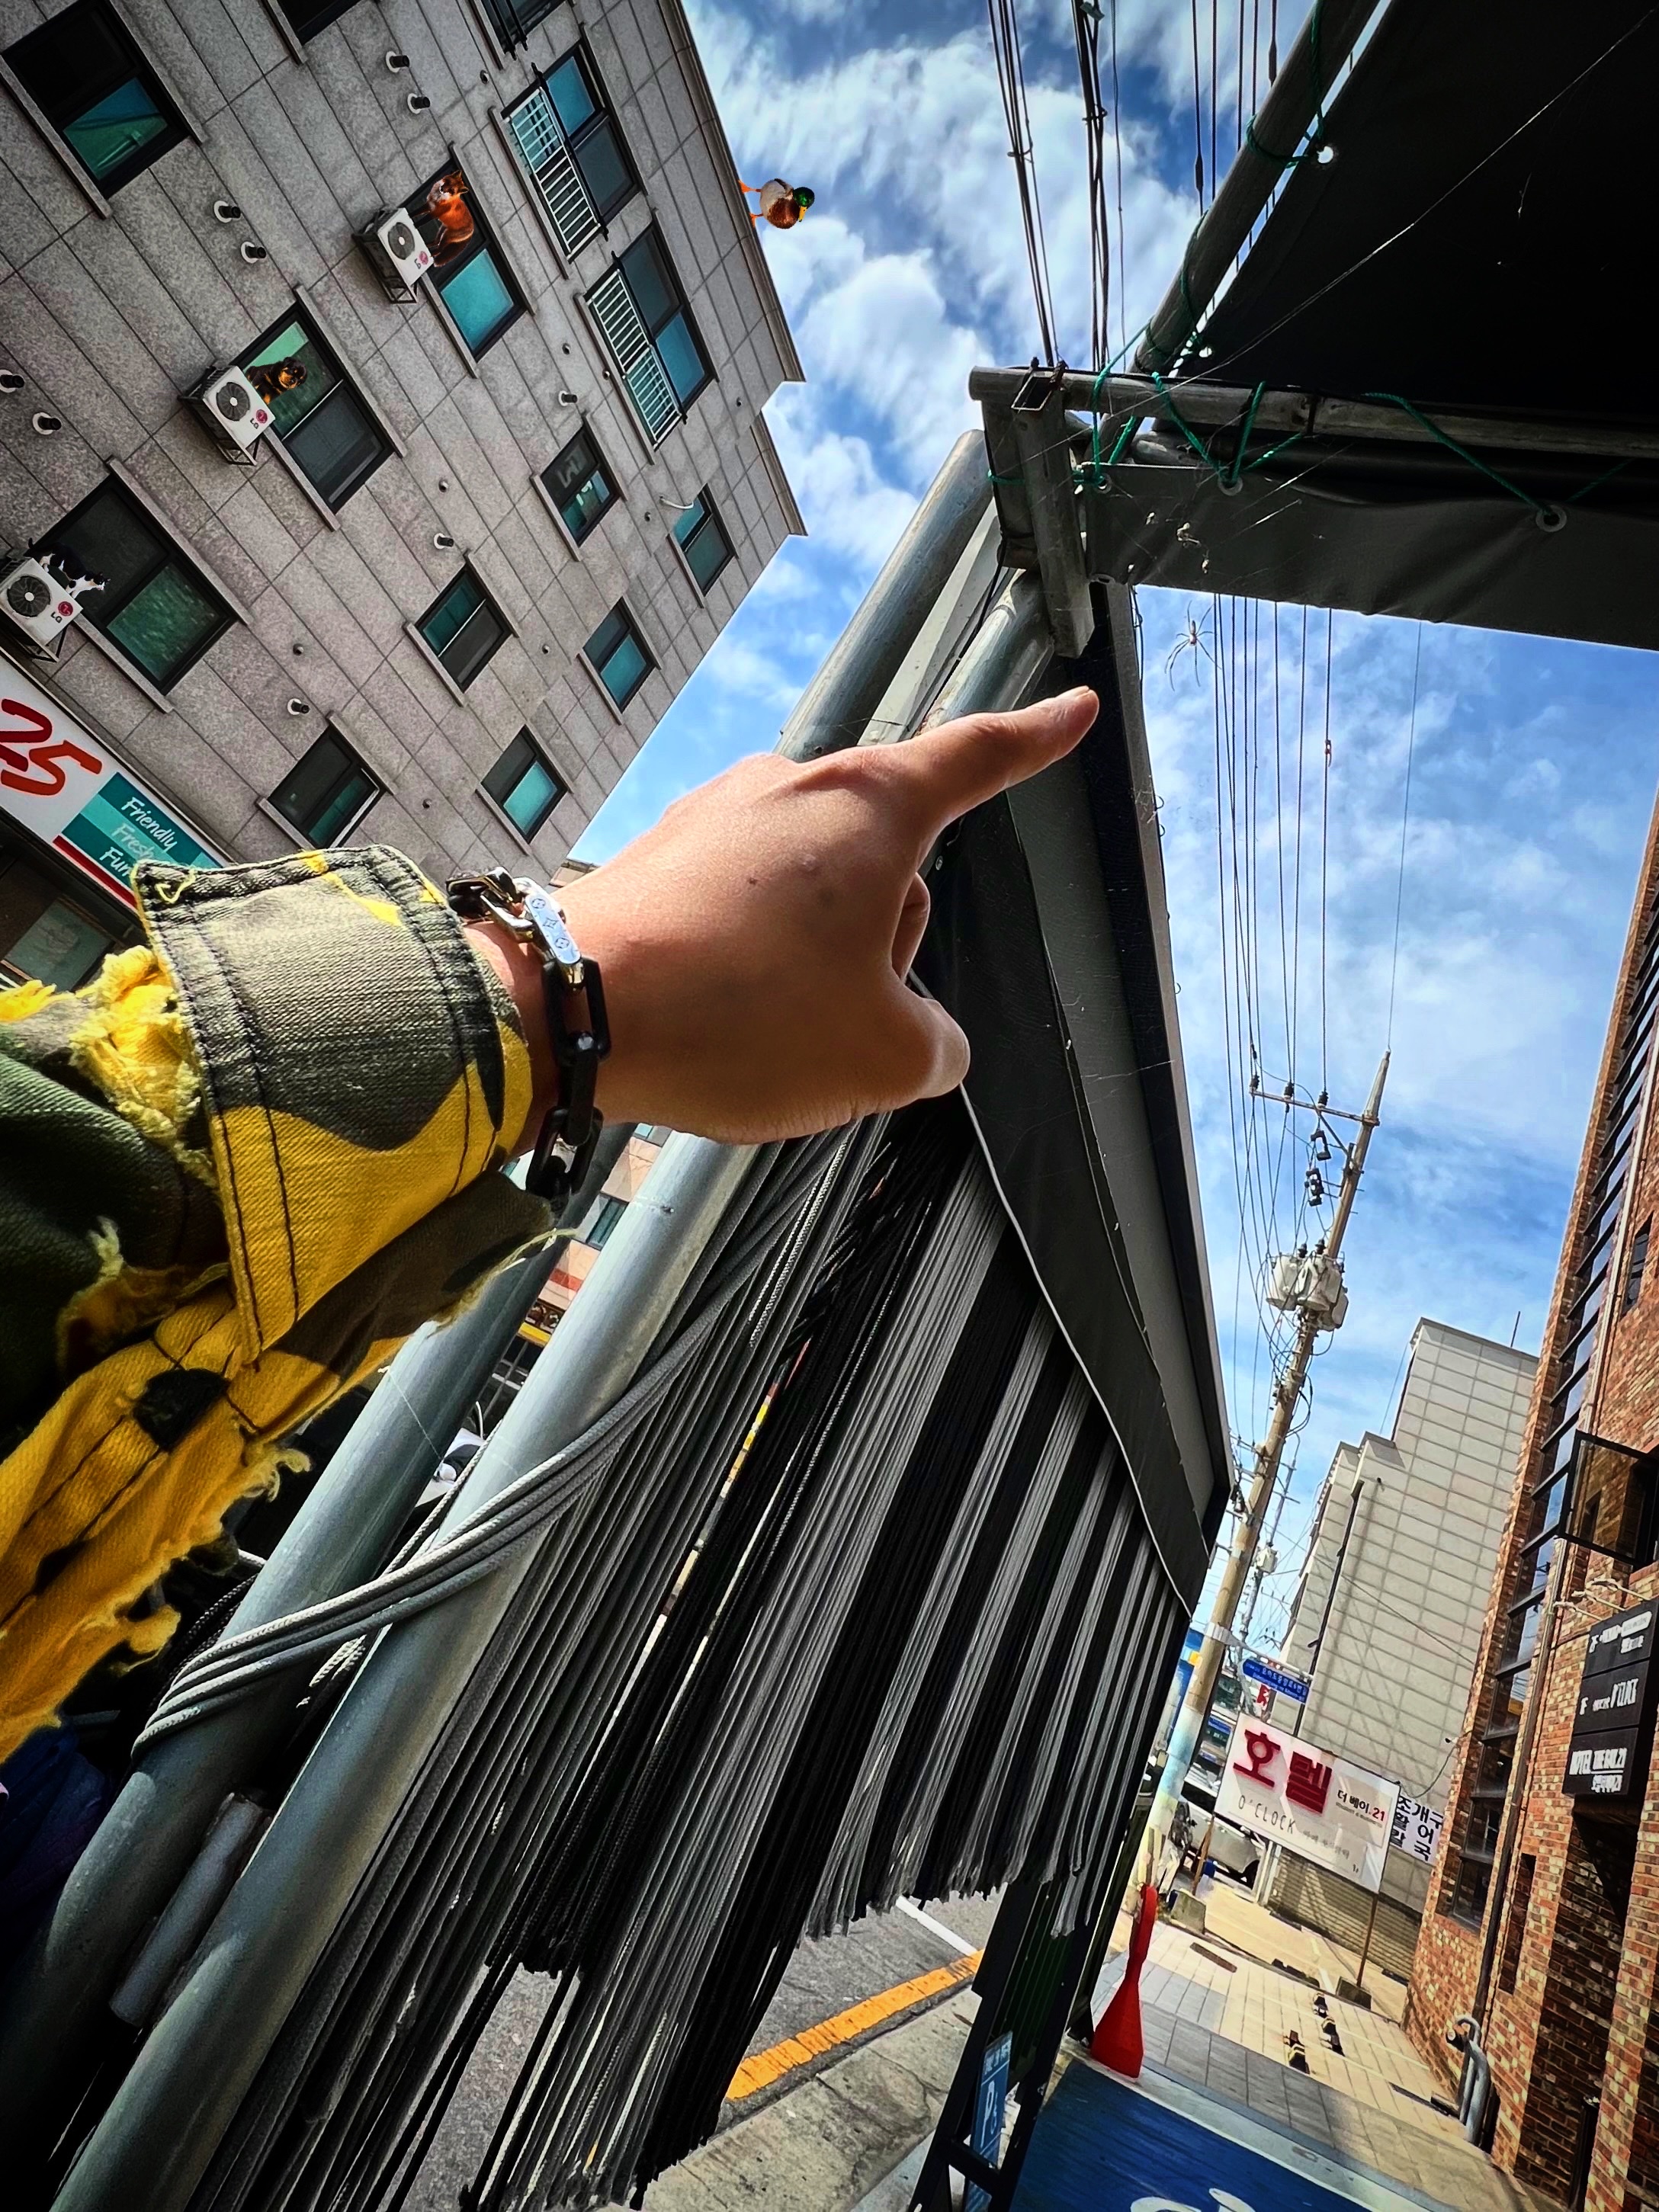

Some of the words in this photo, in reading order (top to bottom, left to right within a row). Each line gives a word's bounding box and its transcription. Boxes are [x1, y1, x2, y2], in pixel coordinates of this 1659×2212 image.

[249, 417, 259, 429] LG
[50, 611, 63, 624] LG
[0, 698, 103, 796] 25
[120, 797, 178, 854] Friendly
[1337, 1789, 1347, 1803] 더
[1238, 1794, 1296, 1835] O'CLOCK
